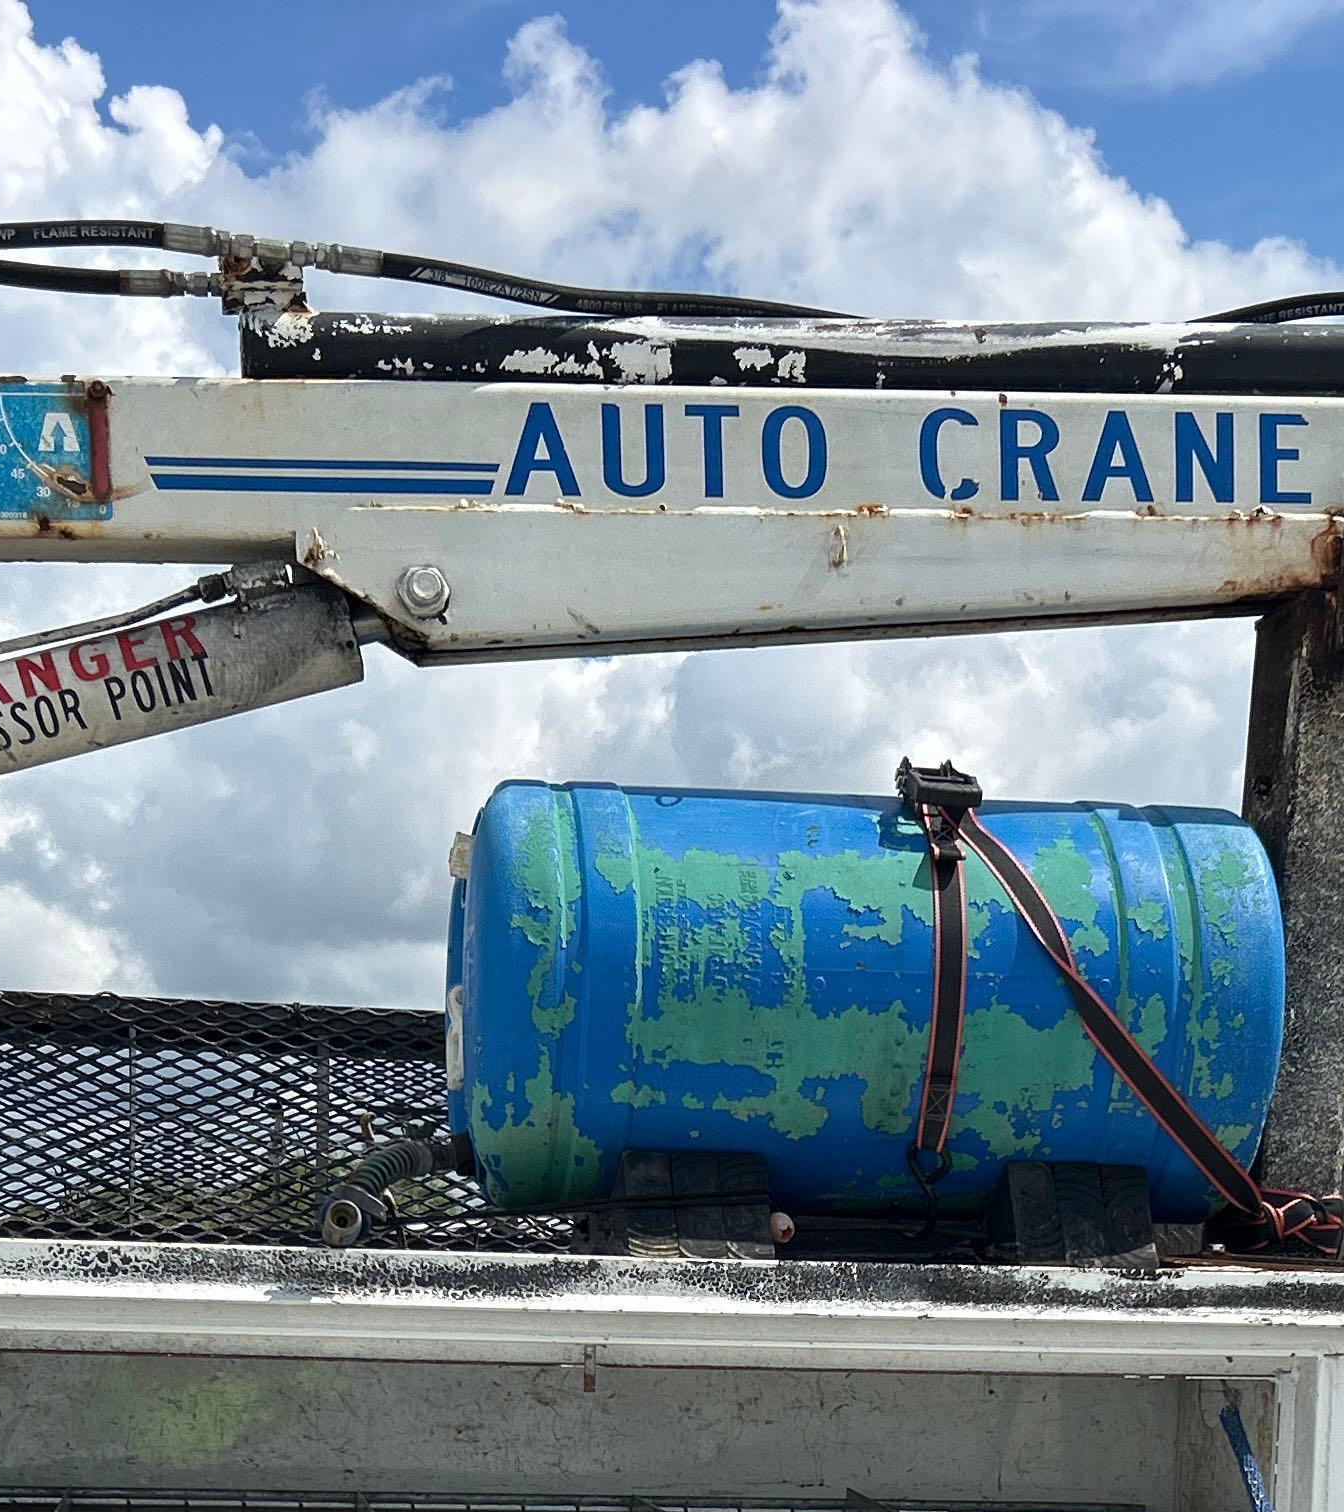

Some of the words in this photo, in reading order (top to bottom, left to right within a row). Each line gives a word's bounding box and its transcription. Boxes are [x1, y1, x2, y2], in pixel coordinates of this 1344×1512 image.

[33, 225, 78, 240] FLAME
[82, 225, 155, 240] RESISTANT
[1278, 303, 1344, 320] RESISTANT
[504, 402, 827, 498] AUTO
[919, 407, 1313, 503] CRANE
[11, 468, 25, 479] 45
[36, 486, 51, 497] 30
[99, 505, 106, 515] 0
[107, 652, 215, 720] POINT
